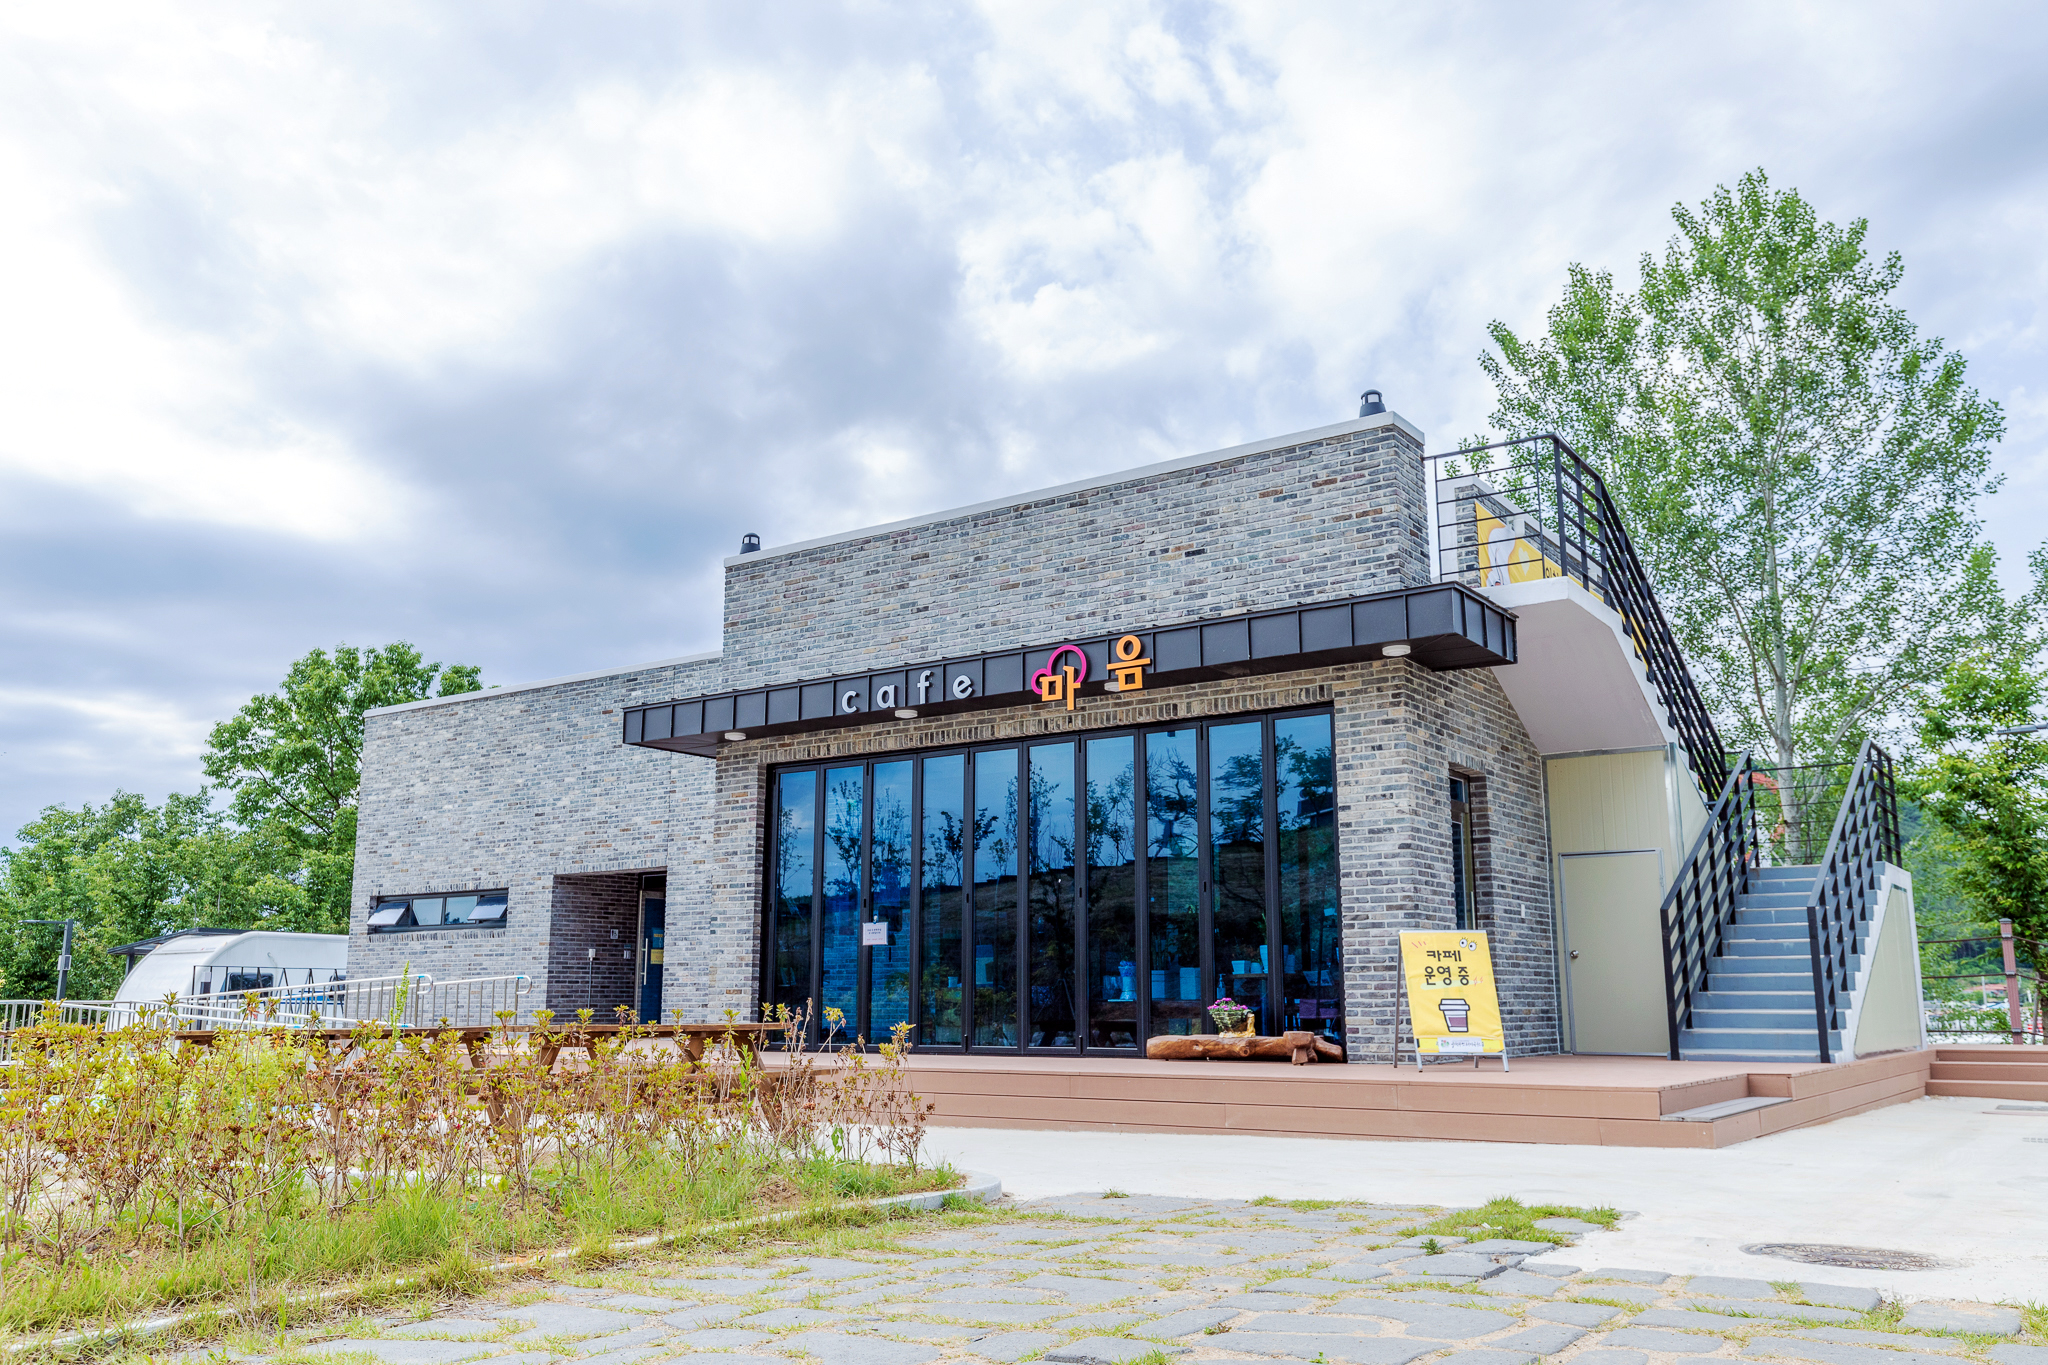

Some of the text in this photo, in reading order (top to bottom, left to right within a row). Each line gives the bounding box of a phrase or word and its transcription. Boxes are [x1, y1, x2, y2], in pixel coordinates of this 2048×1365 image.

[841, 634, 1152, 713] cafe 마음
[1426, 950, 1461, 962] 카페
[1424, 965, 1469, 986] 운영 중
